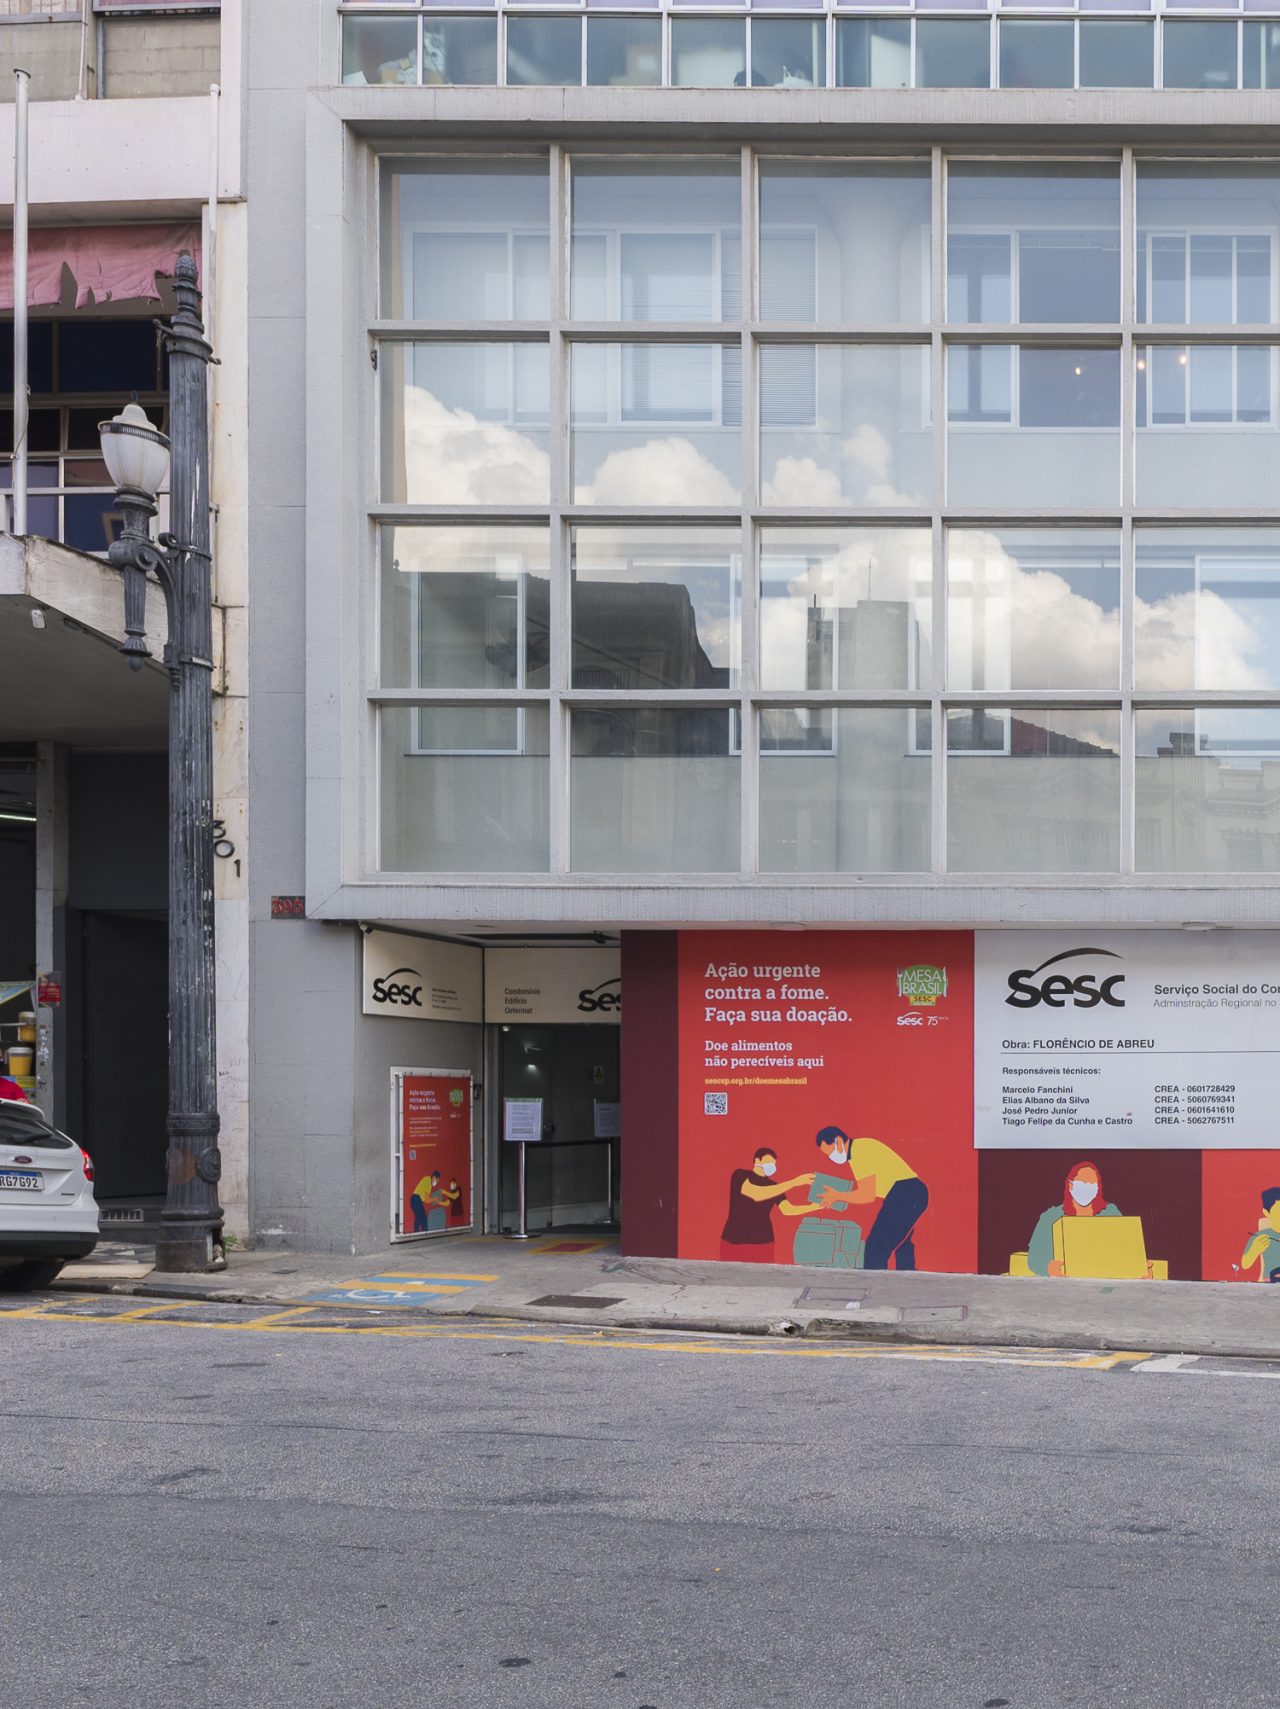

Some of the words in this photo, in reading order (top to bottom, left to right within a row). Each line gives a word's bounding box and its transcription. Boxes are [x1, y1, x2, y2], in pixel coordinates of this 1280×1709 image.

[704, 963, 748, 981] Ação
[753, 966, 821, 981] urgente
[903, 969, 942, 983] MESA
[704, 986, 763, 1000] contra
[766, 989, 777, 1000] a
[781, 985, 829, 1000] fome.
[903, 982, 942, 994] BRASIL
[1154, 984, 1199, 997] Serviço
[1202, 984, 1239, 995] Social
[1242, 984, 1258, 994] do
[577, 978, 621, 1012] Se
[1221, 998, 1262, 1009] Regional
[1265, 999, 1277, 1008] no
[704, 1007, 746, 1026] Faça
[751, 1011, 782, 1022] sua
[786, 1006, 852, 1026] doação.
[704, 1041, 728, 1051] Doe
[731, 1040, 793, 1051] alimentos
[1002, 1039, 1031, 1049] Obra:
[1033, 1037, 1096, 1049] FLORÊNCIO
[1099, 1039, 1113, 1049] DE
[1117, 1039, 1155, 1049] ABREU
[704, 1056, 727, 1067] não
[730, 1055, 794, 1070] perecíveis
[797, 1056, 824, 1070] aqui
[1002, 1066, 1061, 1077] Responsáveis
[1062, 1066, 1101, 1075] técnicos:
[1002, 1086, 1036, 1094] Marcelo
[1037, 1085, 1074, 1094] Fanchini
[1154, 1085, 1179, 1093] CREA
[1187, 1085, 1236, 1093] 0601728429
[1002, 1096, 1023, 1104] Elias
[1024, 1096, 1055, 1104] Albano
[1056, 1096, 1067, 1104] da
[1068, 1096, 1090, 1104] Silva
[1154, 1095, 1179, 1104] CREA
[1002, 1106, 1023, 1115] José
[1024, 1106, 1049, 1115] Pedro
[1050, 1106, 1078, 1115] Junior
[1154, 1106, 1179, 1114] CREA
[1002, 1117, 1026, 1127] Tiago
[1028, 1117, 1053, 1127] Felipe
[1055, 1117, 1066, 1125] da
[1067, 1116, 1096, 1125] Cunha
[1105, 1117, 1133, 1125] Castro
[1154, 1116, 1179, 1125] CREA
[1187, 1116, 1235, 1124] 5062767511
[0, 1175, 39, 1189] RG7G92
